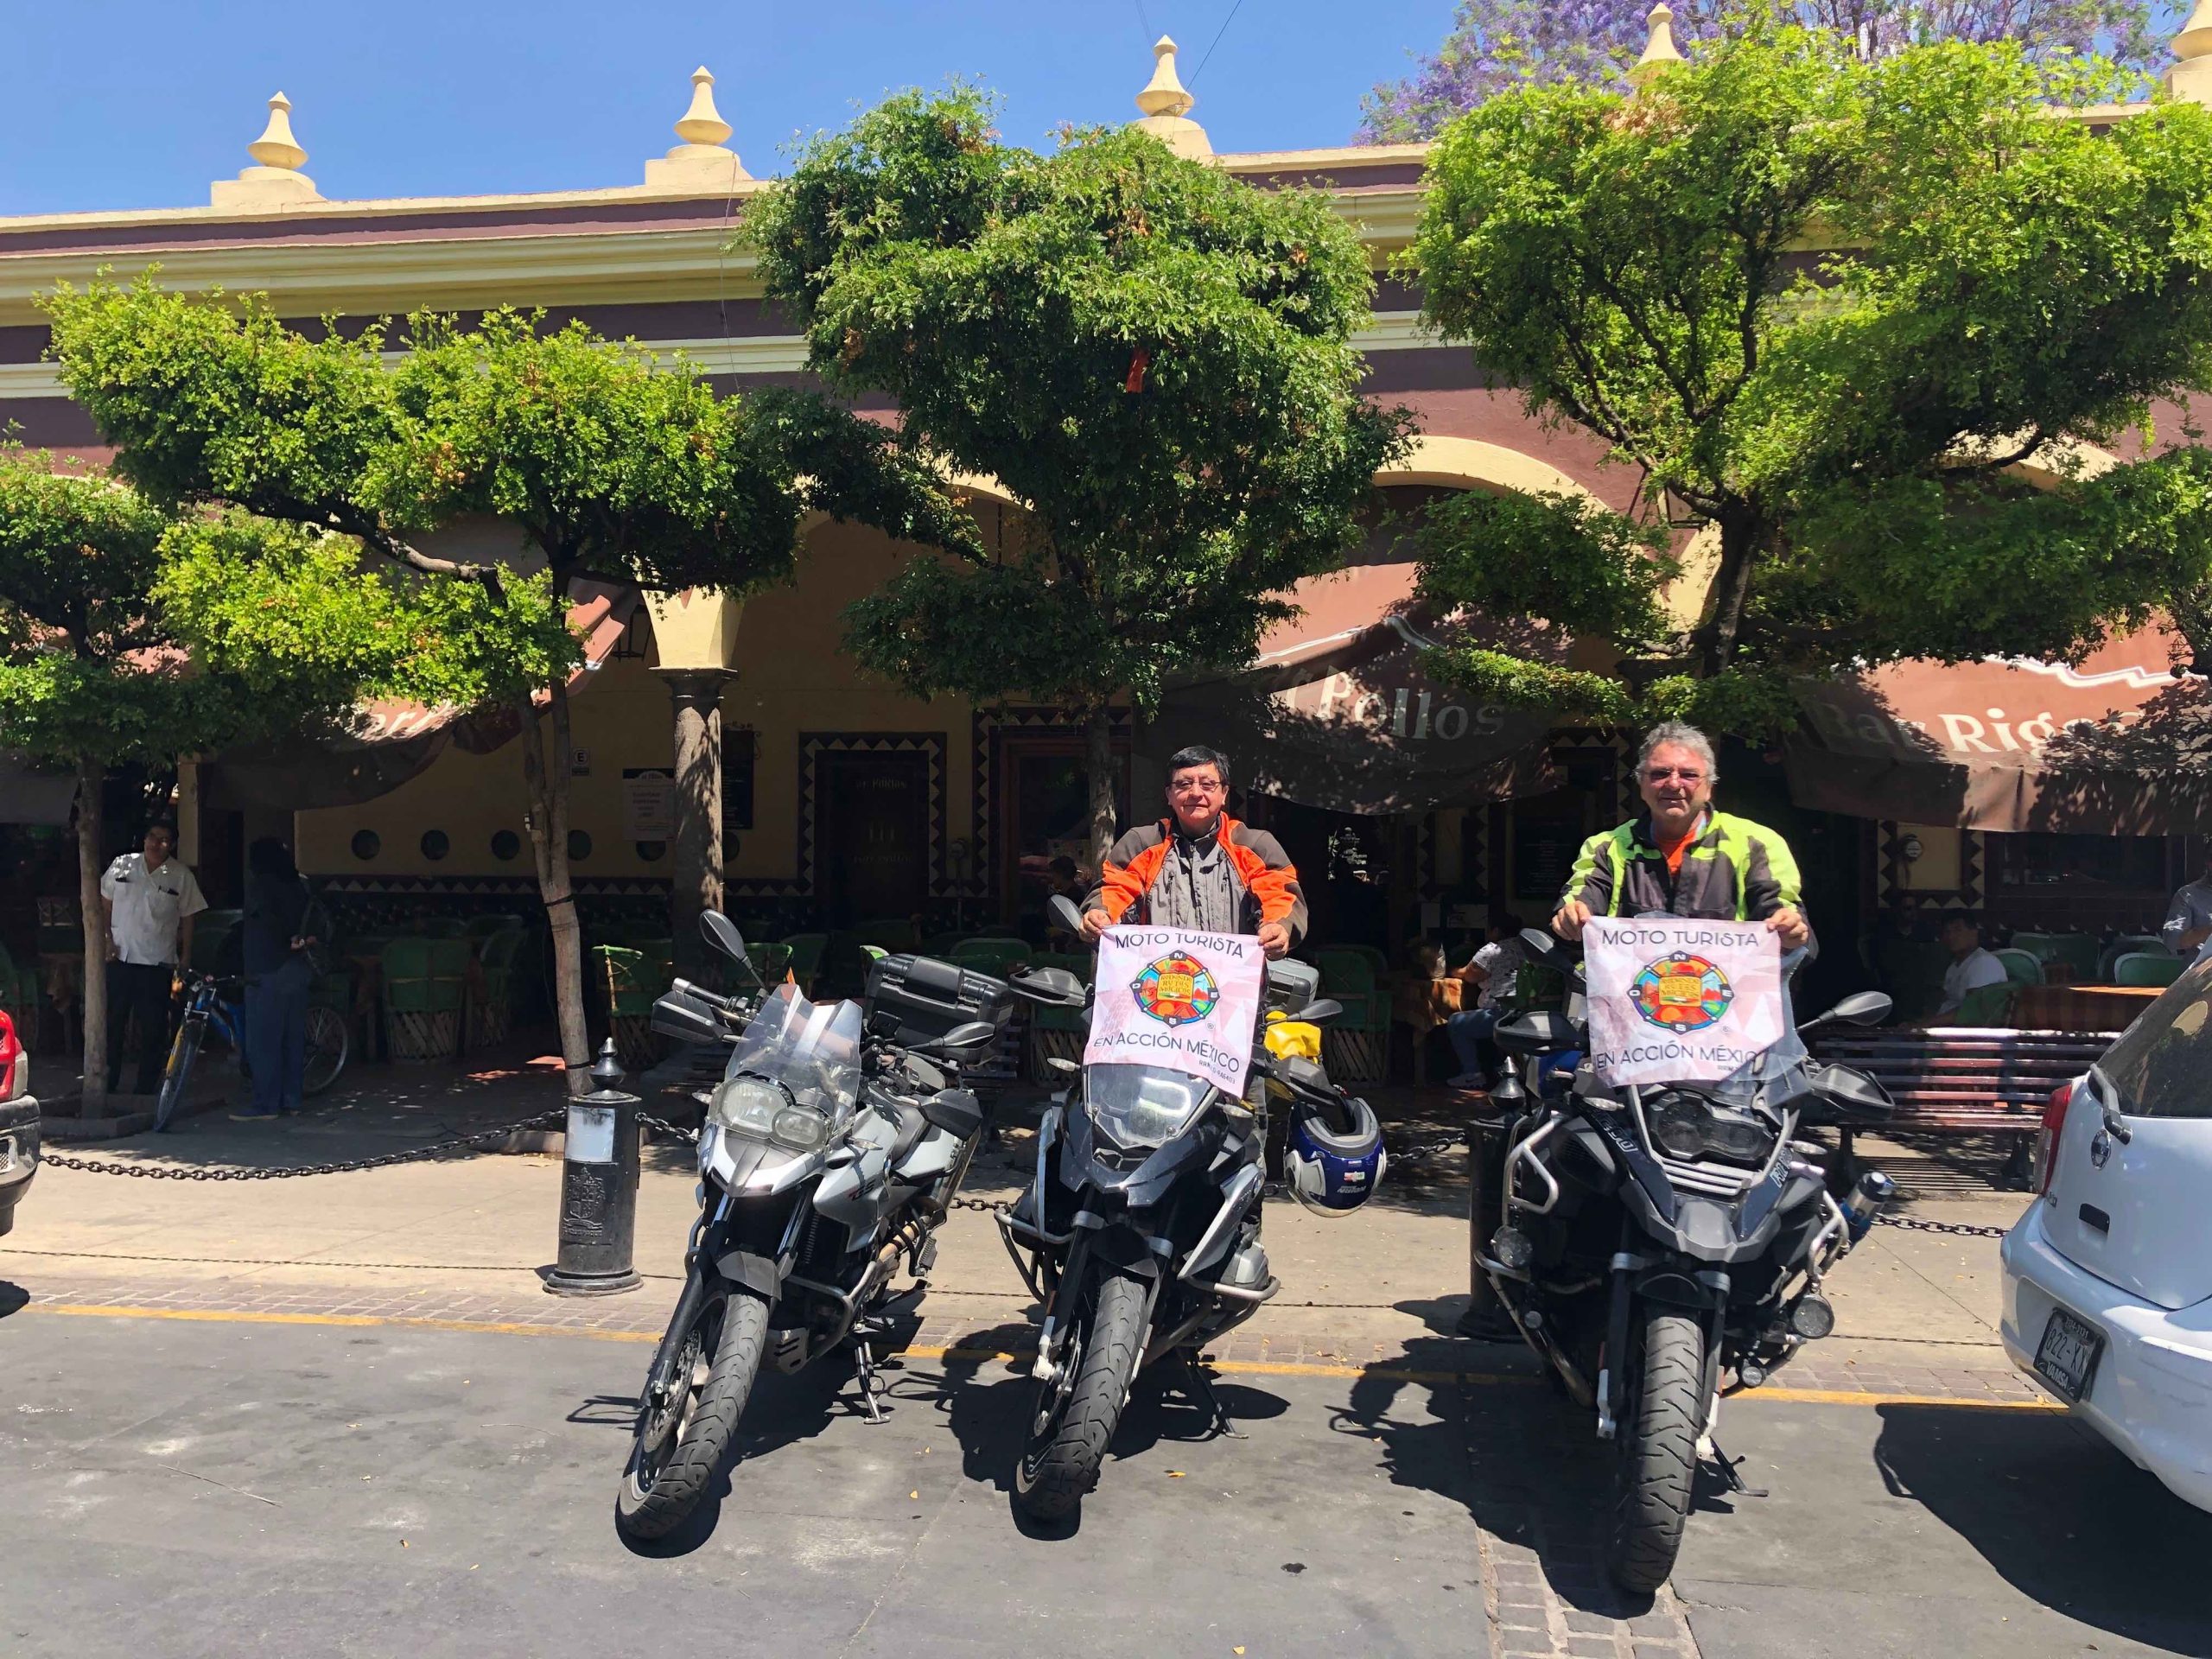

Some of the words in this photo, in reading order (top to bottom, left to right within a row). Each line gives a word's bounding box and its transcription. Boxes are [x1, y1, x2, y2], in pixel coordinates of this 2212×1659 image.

[577, 753, 584, 762] E
[1116, 932, 1169, 949] MOTO
[1175, 932, 1243, 958] TURISTA
[1601, 930, 1666, 945] MOTO
[1673, 931, 1759, 947] TURISTA
[1094, 1035, 1114, 1047] EN
[1116, 1032, 1182, 1050] ACCIÓN
[1187, 1039, 1240, 1073] MÉXICO
[1596, 1050, 1615, 1069] EN
[1619, 1039, 1694, 1065] ACCIÓN
